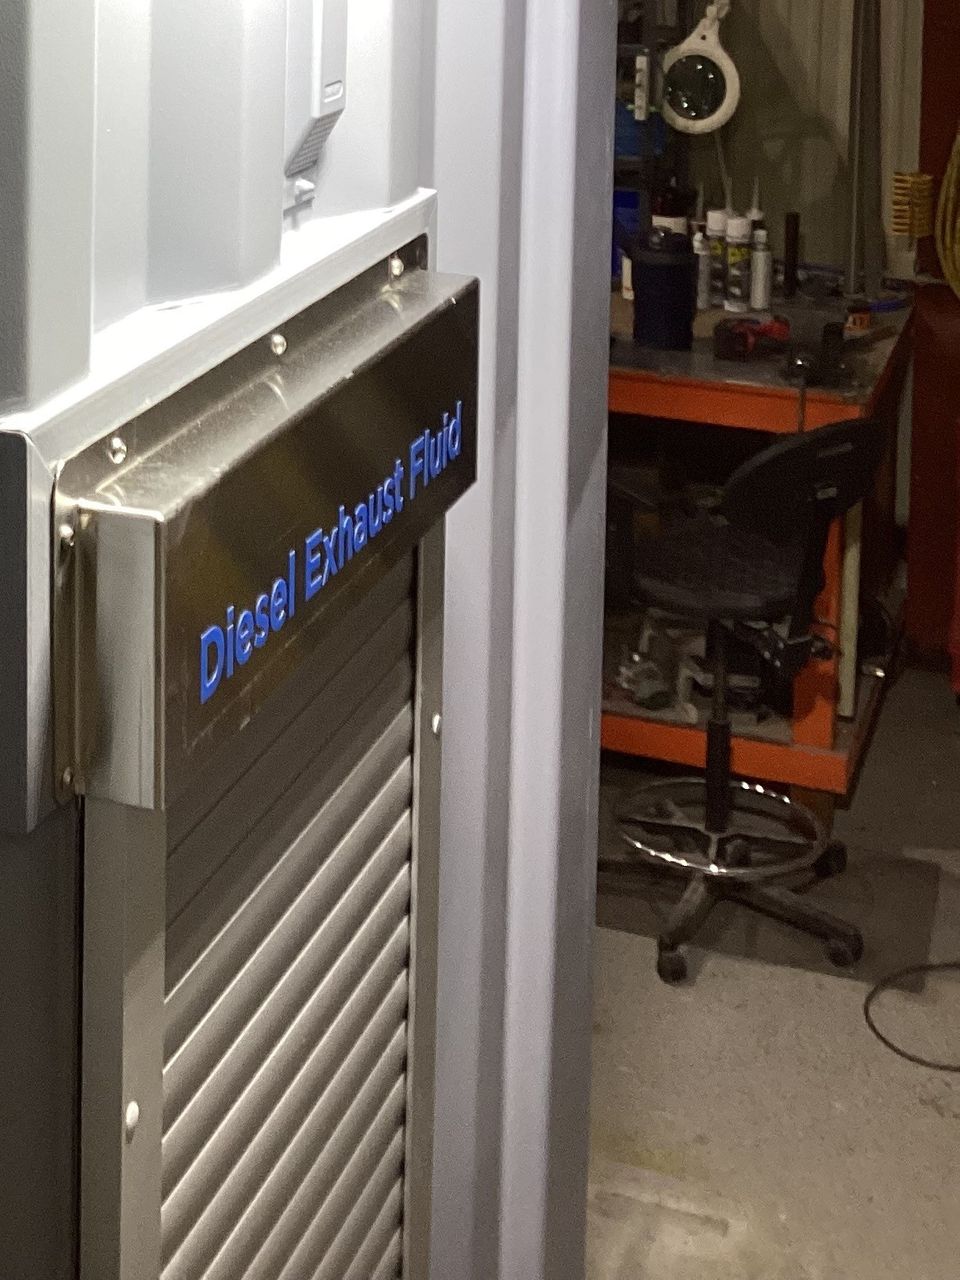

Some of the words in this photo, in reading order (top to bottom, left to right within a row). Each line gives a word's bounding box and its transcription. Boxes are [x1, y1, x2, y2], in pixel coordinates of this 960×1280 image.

[200, 548, 295, 705] Diesel
[304, 458, 404, 602] Exhaust
[410, 400, 462, 500] Fluid
